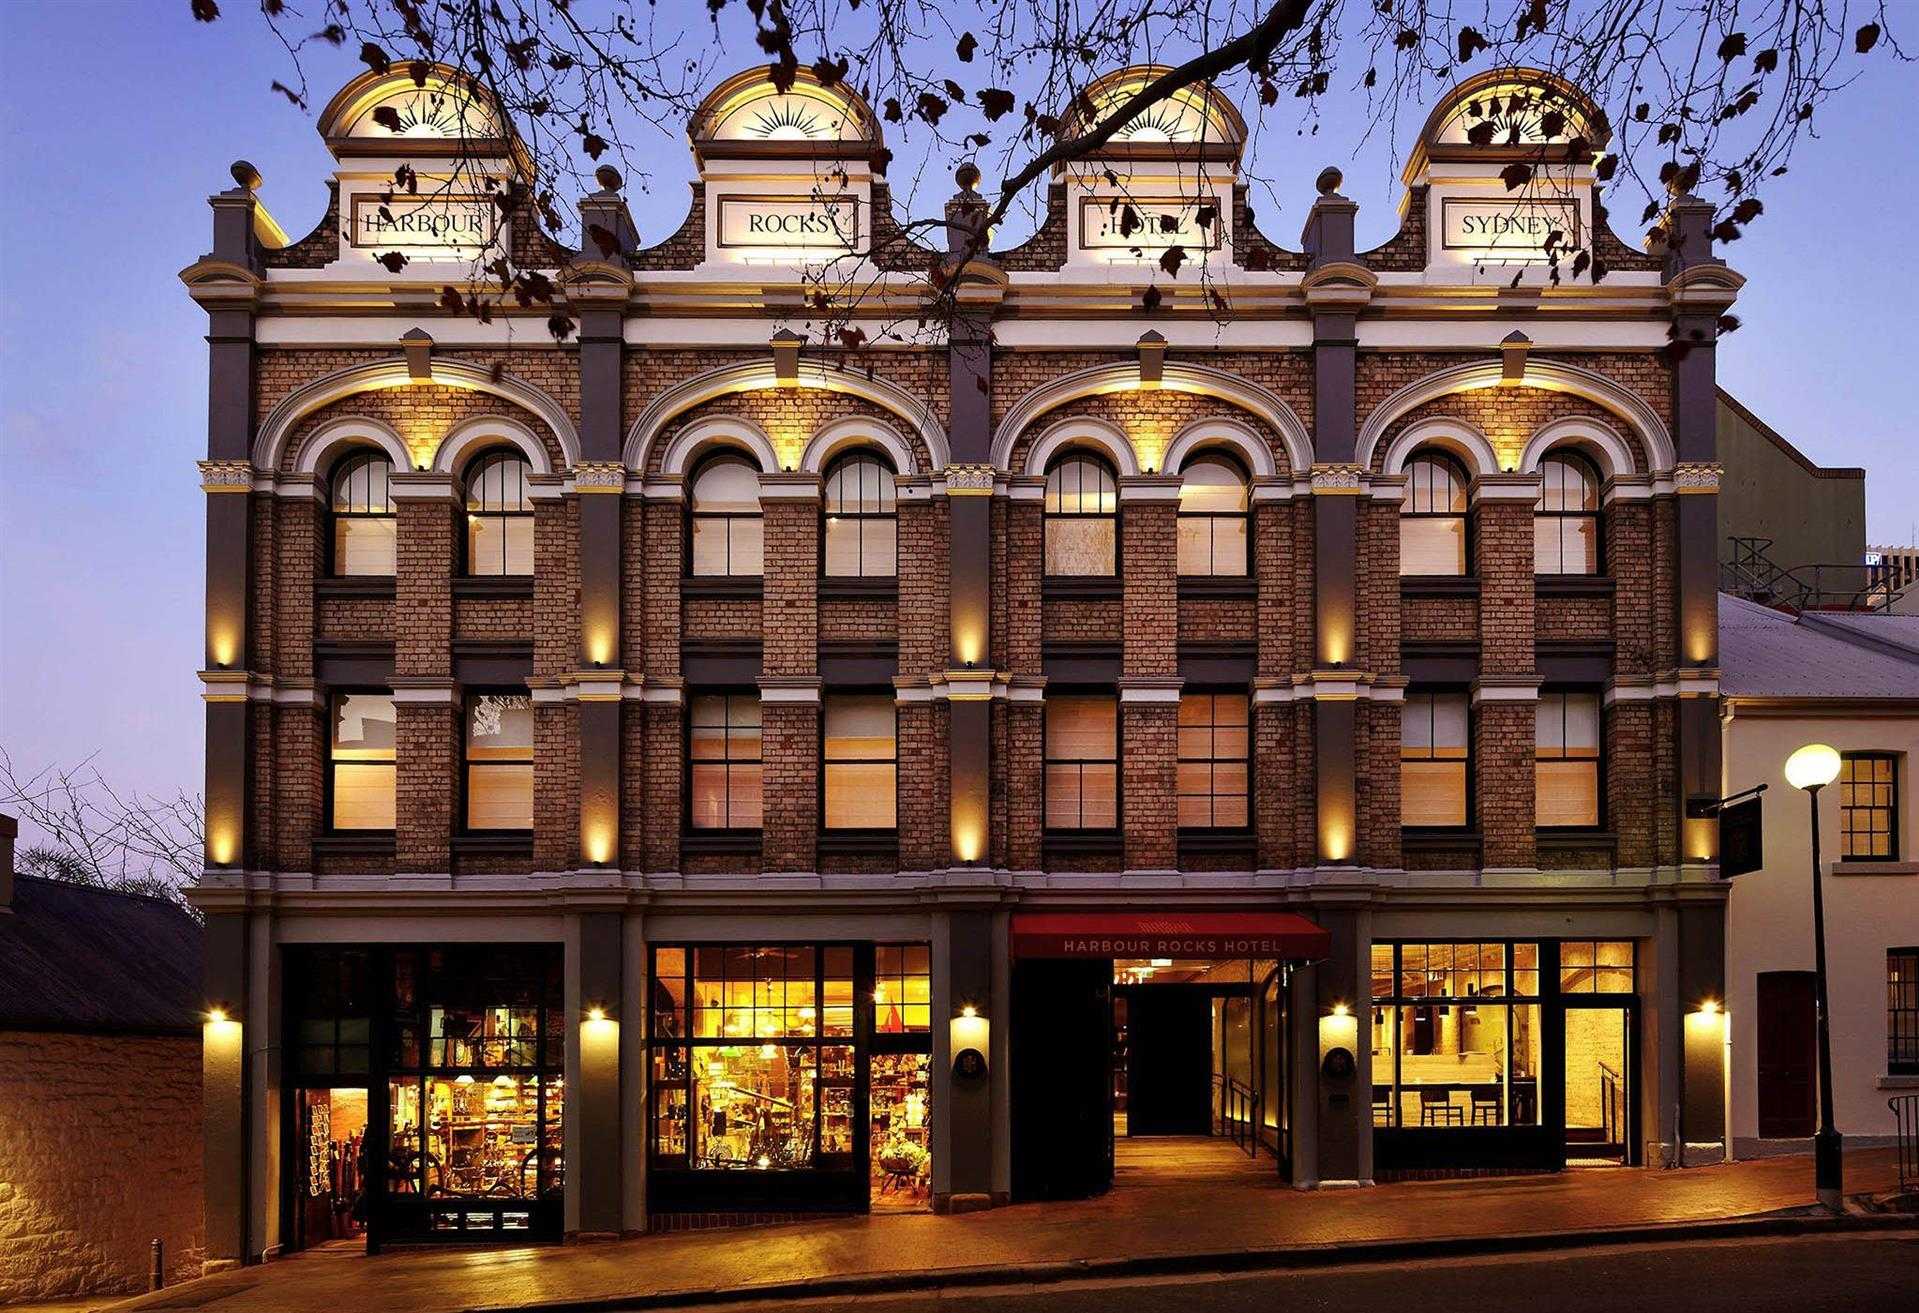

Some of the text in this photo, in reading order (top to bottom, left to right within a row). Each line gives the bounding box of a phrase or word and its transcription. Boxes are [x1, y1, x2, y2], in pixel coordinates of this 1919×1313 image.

[364, 214, 484, 233] HARBOUR
[749, 214, 829, 233] ROCKS
[1462, 215, 1560, 234] SYDNEY
[1064, 940, 1281, 952] HARBOUR ROCKS HOTEL
